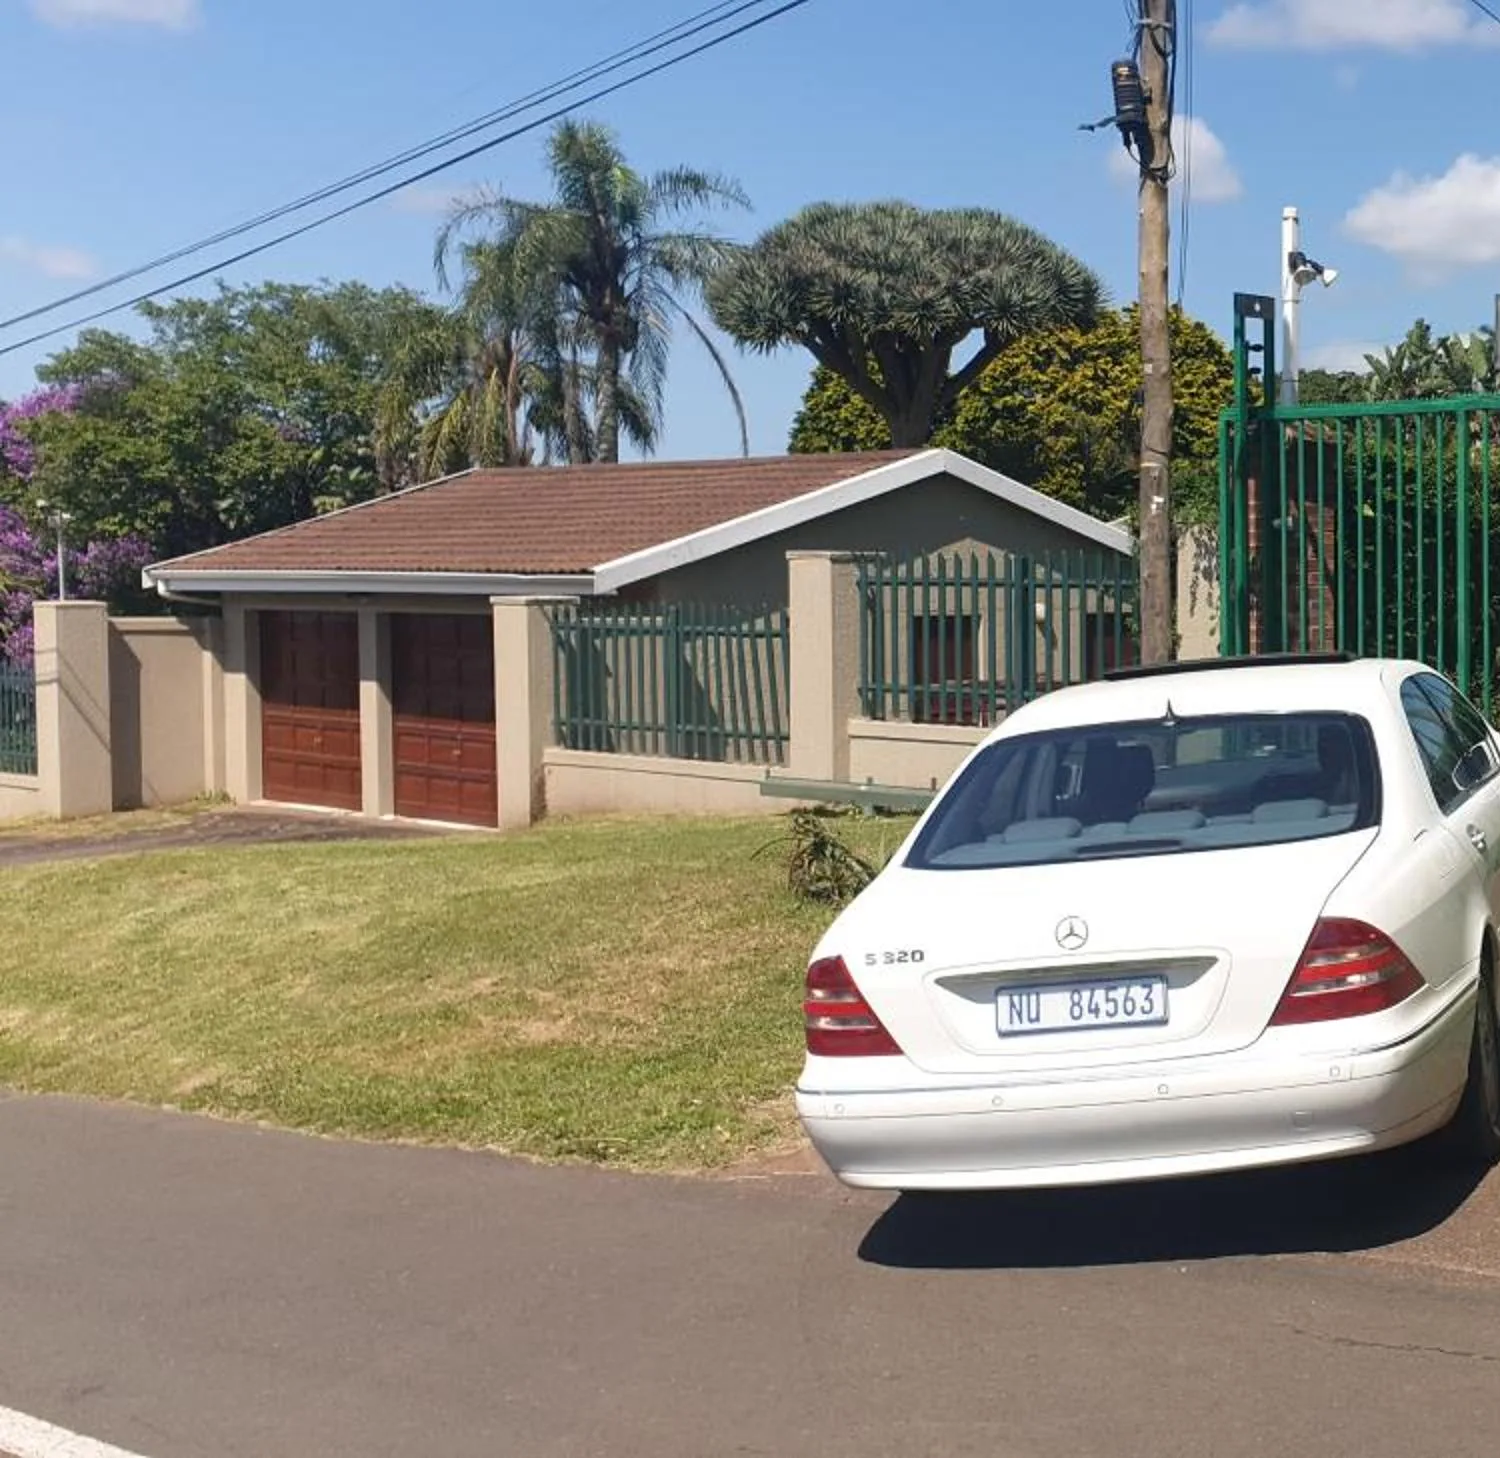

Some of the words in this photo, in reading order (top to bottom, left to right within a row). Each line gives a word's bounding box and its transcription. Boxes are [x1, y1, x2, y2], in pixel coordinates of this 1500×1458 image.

[865, 952, 878, 967] S
[882, 948, 925, 965] 320
[1008, 991, 1041, 1025] NU
[1069, 981, 1154, 1021] 84563
